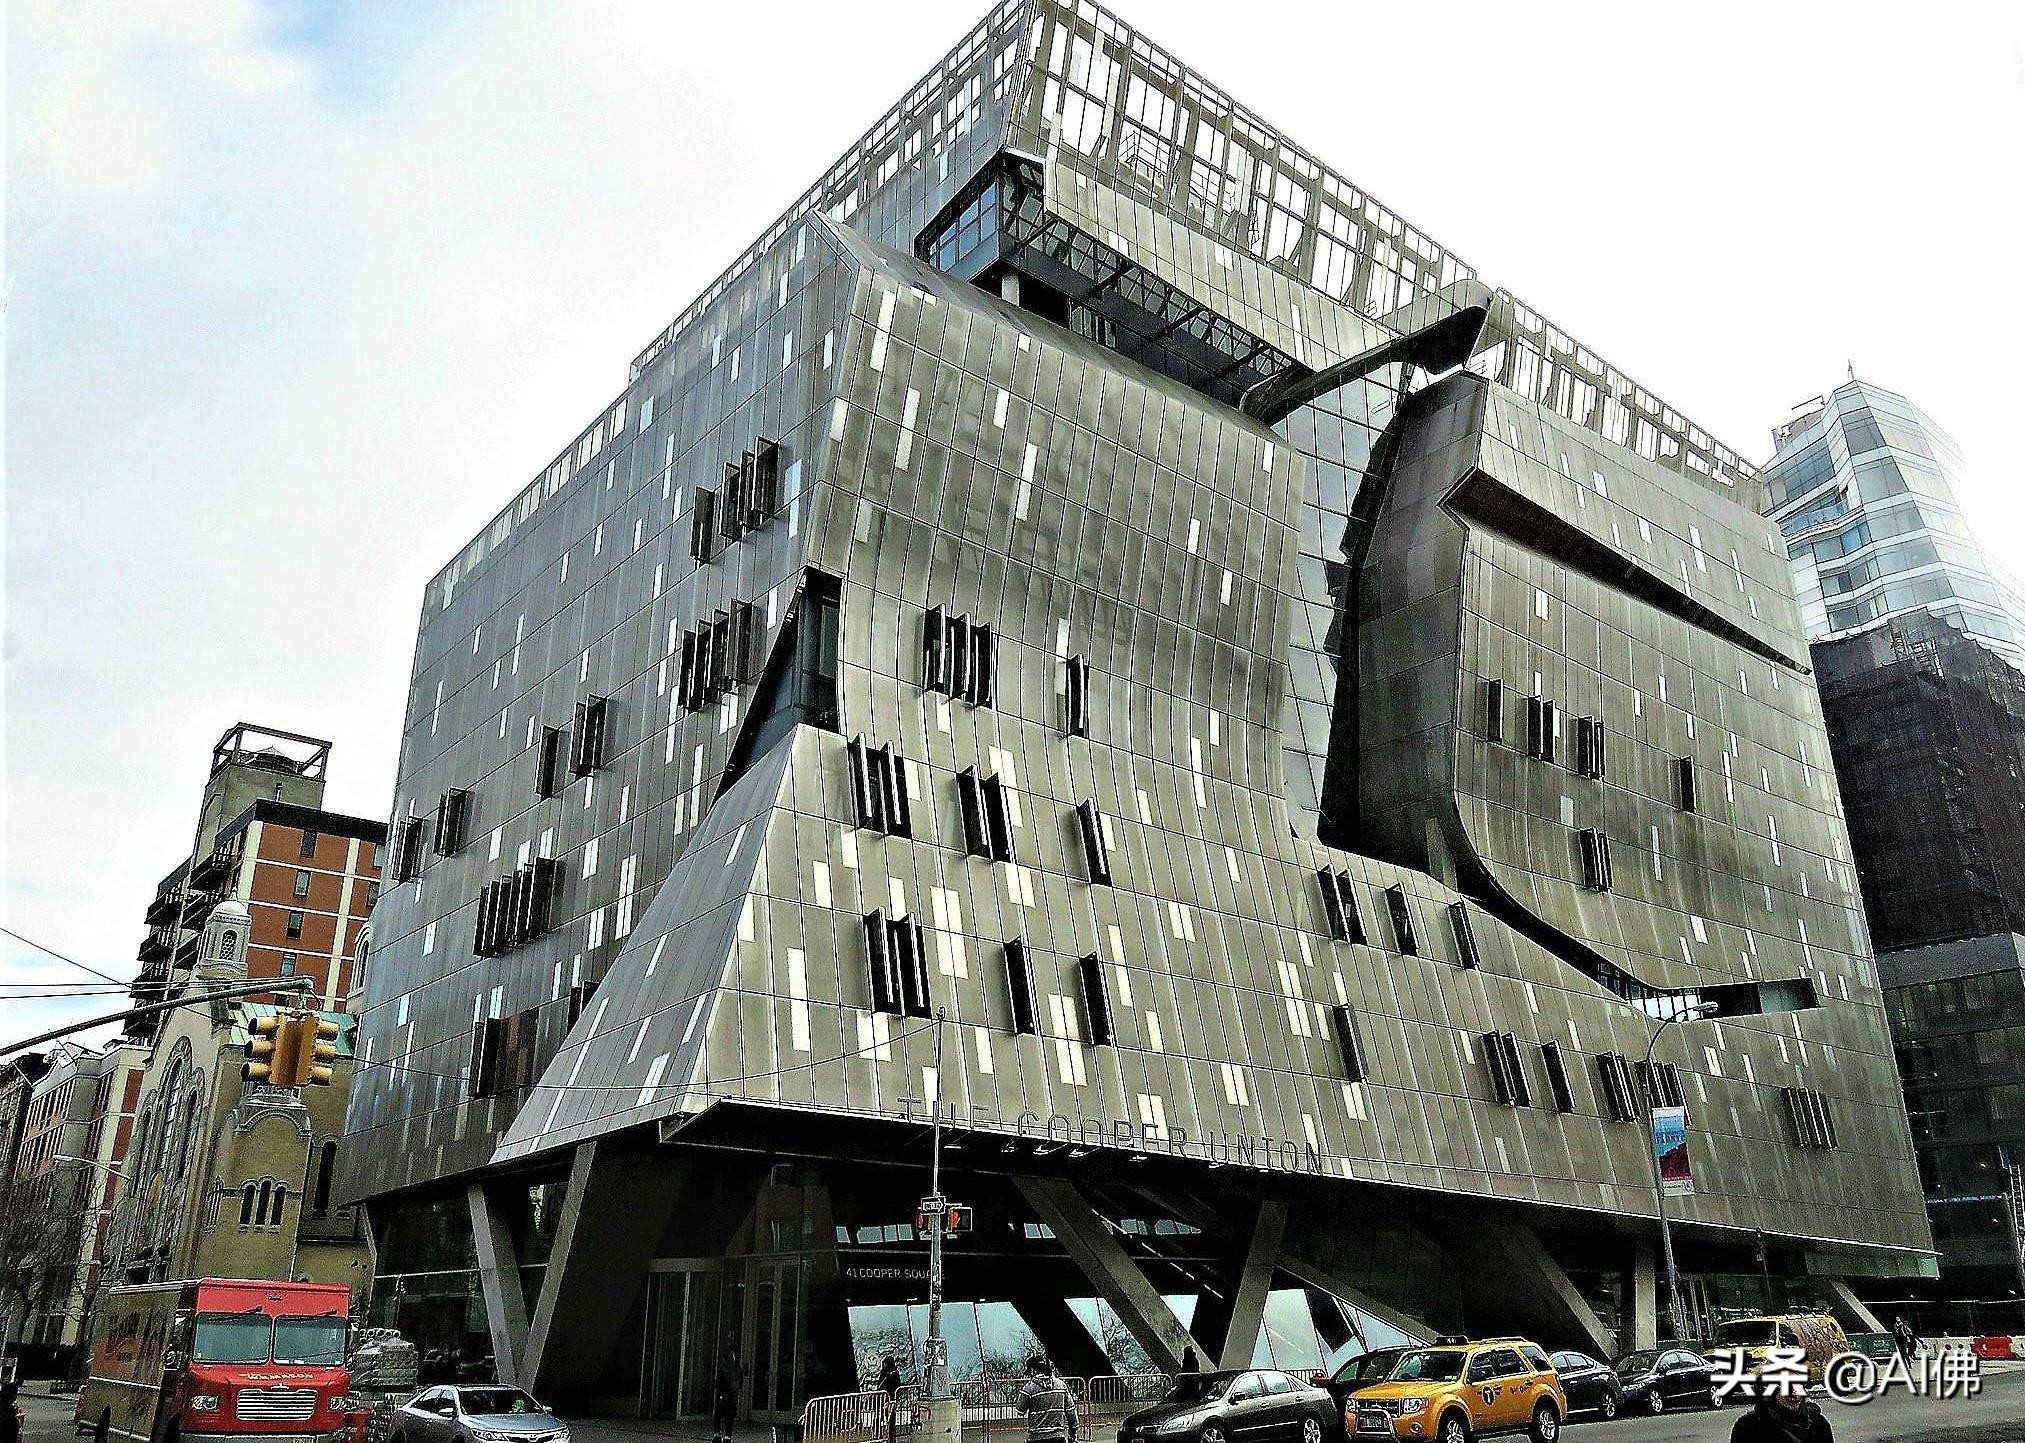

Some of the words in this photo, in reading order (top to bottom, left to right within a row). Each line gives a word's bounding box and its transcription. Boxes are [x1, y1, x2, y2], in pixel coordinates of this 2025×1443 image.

[1018, 1111, 1188, 1157] COOPER
[1210, 1131, 1321, 1175] UNION
[860, 1268, 901, 1279] COOPER
[904, 1268, 945, 1280] SQUA
